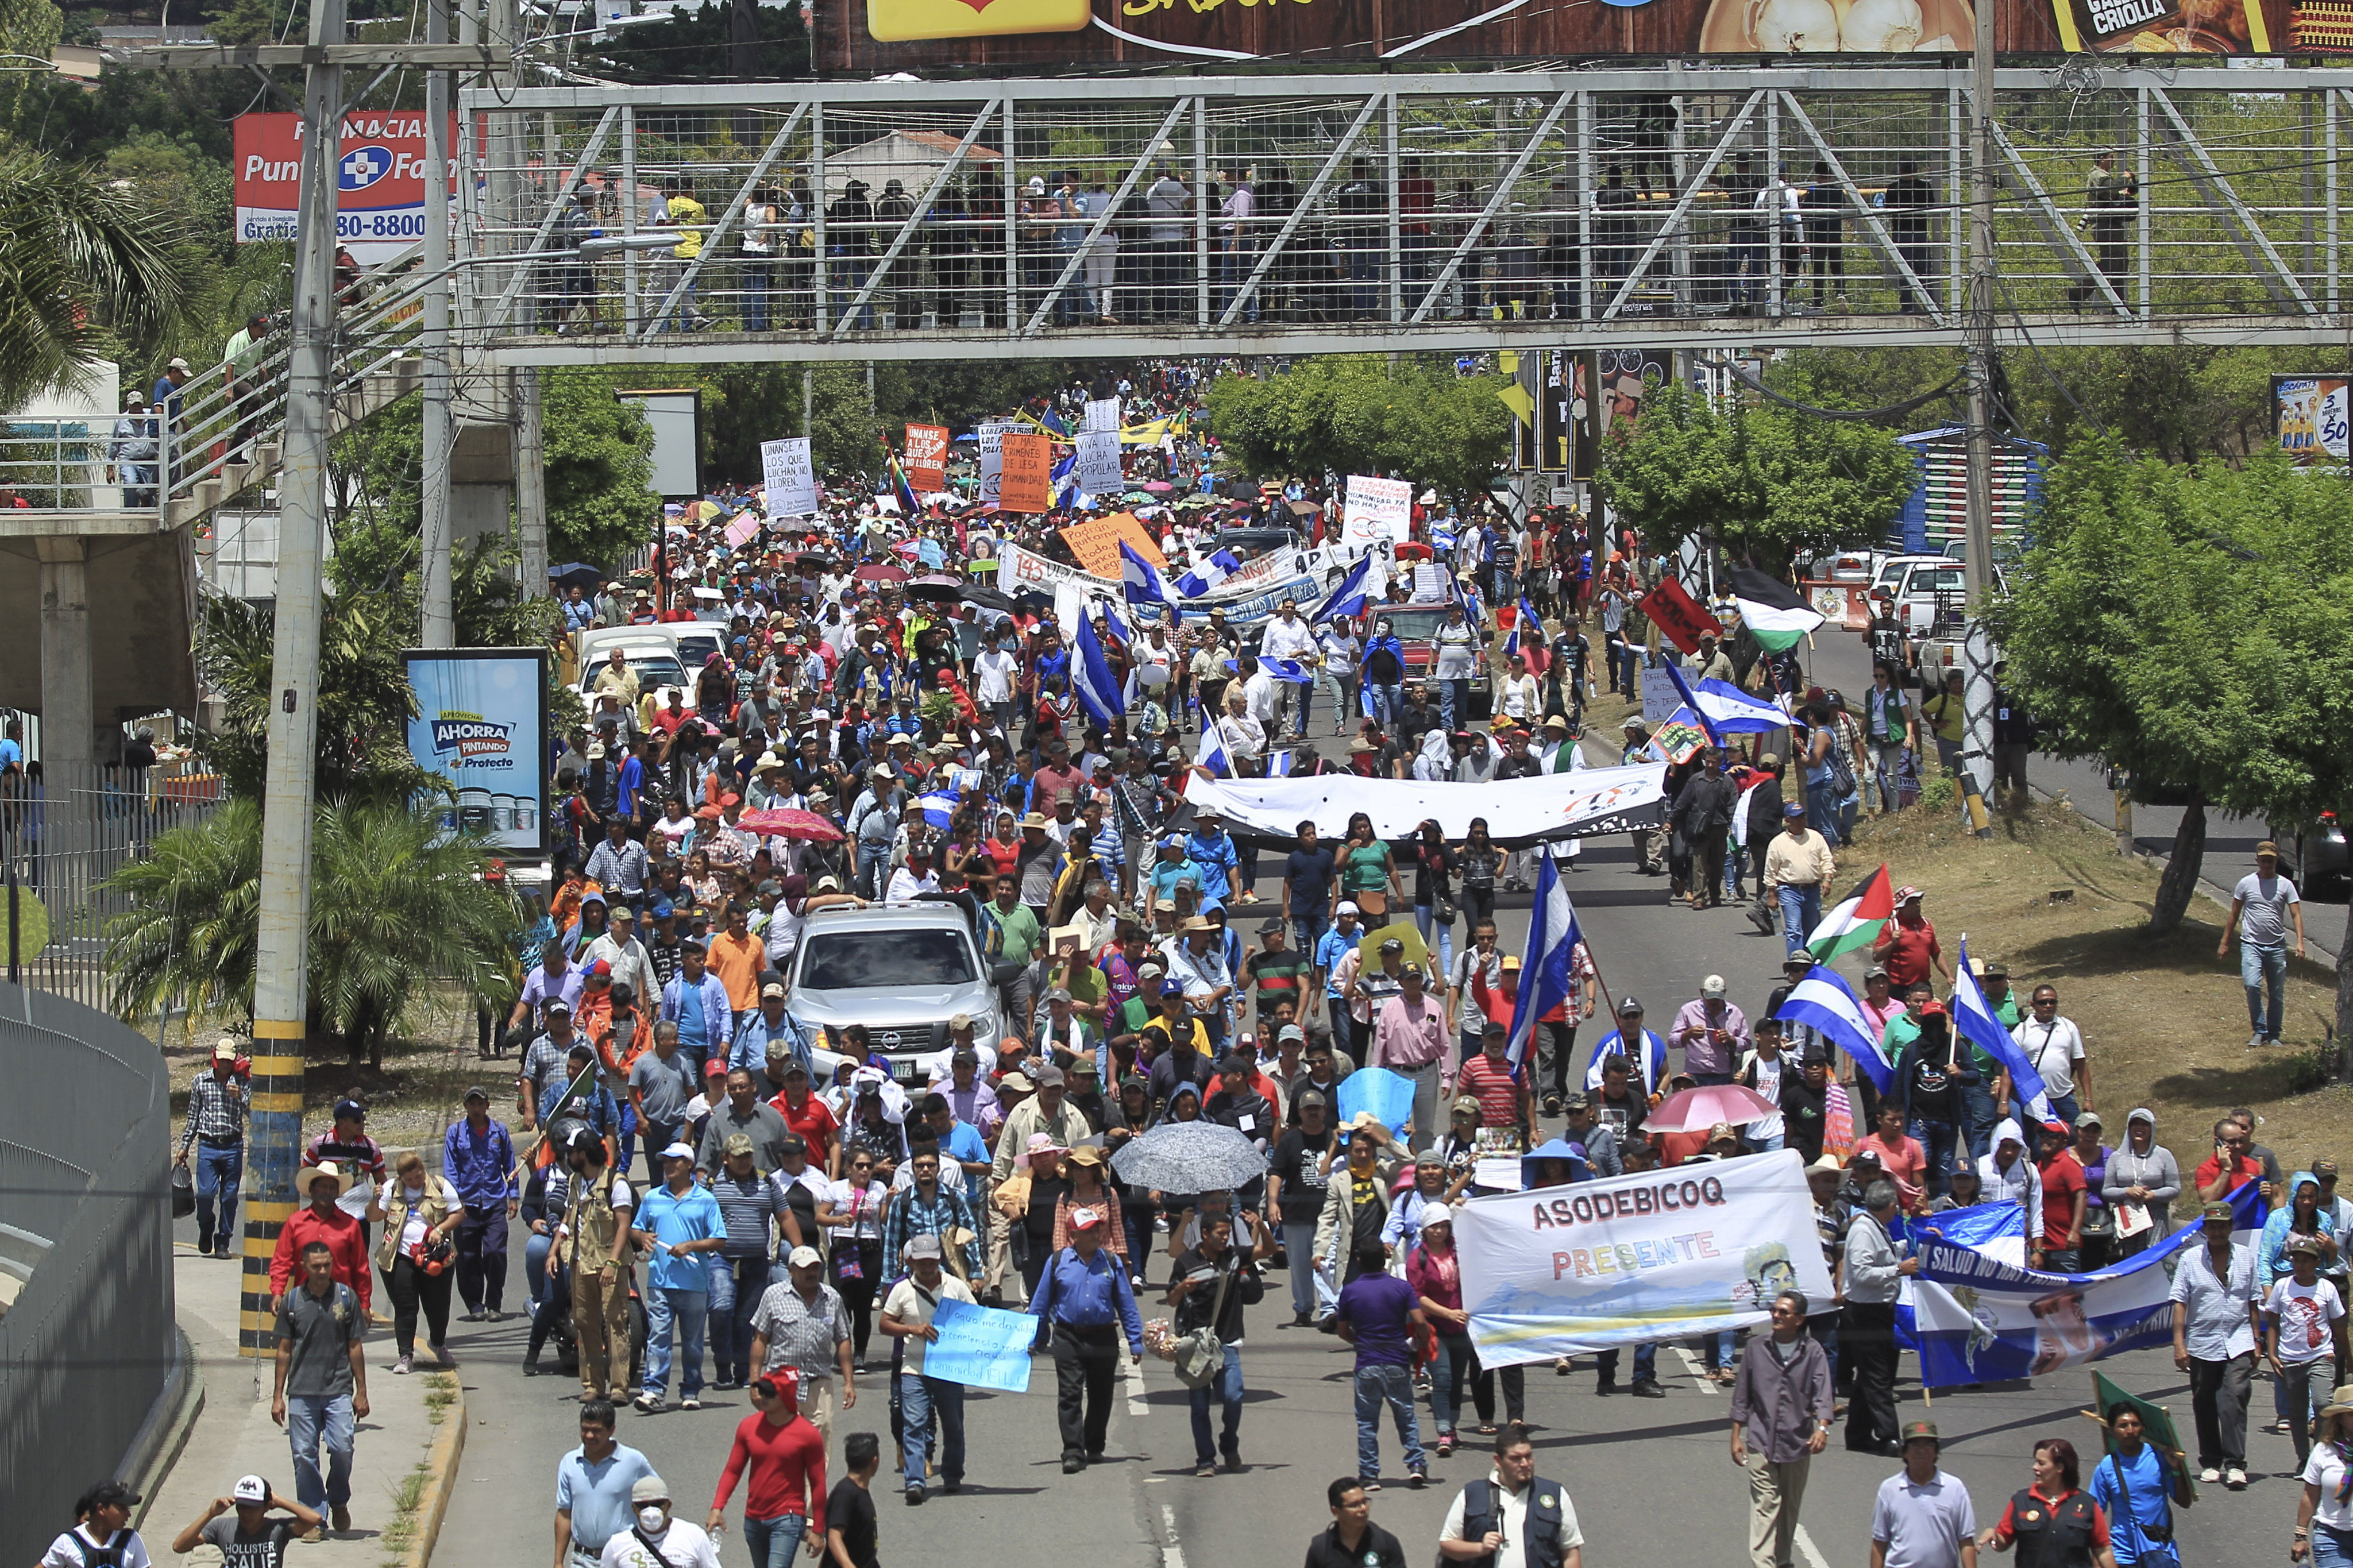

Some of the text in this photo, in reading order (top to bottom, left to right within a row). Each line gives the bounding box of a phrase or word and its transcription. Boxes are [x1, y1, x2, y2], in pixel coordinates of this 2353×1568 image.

[2092, 0, 2166, 34] CRIOLLA
[2324, 395, 2335, 409] 3
[909, 426, 939, 441] ÚNANSE
[2323, 421, 2347, 442] 50
[798, 441, 804, 450] A
[908, 439, 931, 449] A LOS
[1004, 436, 1037, 447] NO MAS
[1078, 437, 1115, 451] VIVA LA
[907, 439, 946, 459] QUE LUCHAN
[1004, 447, 1041, 459] CRIMENES
[766, 454, 804, 468] LOS QUE
[1005, 459, 1037, 469] DE LESA
[1080, 450, 1108, 465] LUCHA
[767, 465, 808, 478] LUCHAN, NO
[905, 458, 944, 472] NO LLOREN.
[1081, 461, 1120, 477] POPULAR.
[768, 477, 799, 489] LLOREN.
[1004, 472, 1044, 486] HUMANIDAD
[1348, 492, 1391, 504] HUMANIDAD
[1362, 501, 1379, 510] HAY
[1067, 523, 1109, 540] Podrán
[1073, 528, 1123, 550] quitarnos
[1087, 553, 1116, 567] nunca
[1016, 553, 1045, 582] 143
[437, 724, 506, 742] AHORRA
[462, 741, 507, 754] PINTANDO
[465, 758, 513, 767] Protecto
[1534, 1176, 1727, 1230] ASODEBICOQ
[1552, 1230, 1721, 1280] PRESENTE
[1932, 1246, 1976, 1275] SALUD
[1975, 1254, 1998, 1278] NO
[225, 1541, 275, 1554] HOLLISTER
[226, 1552, 277, 1568] CALIF
